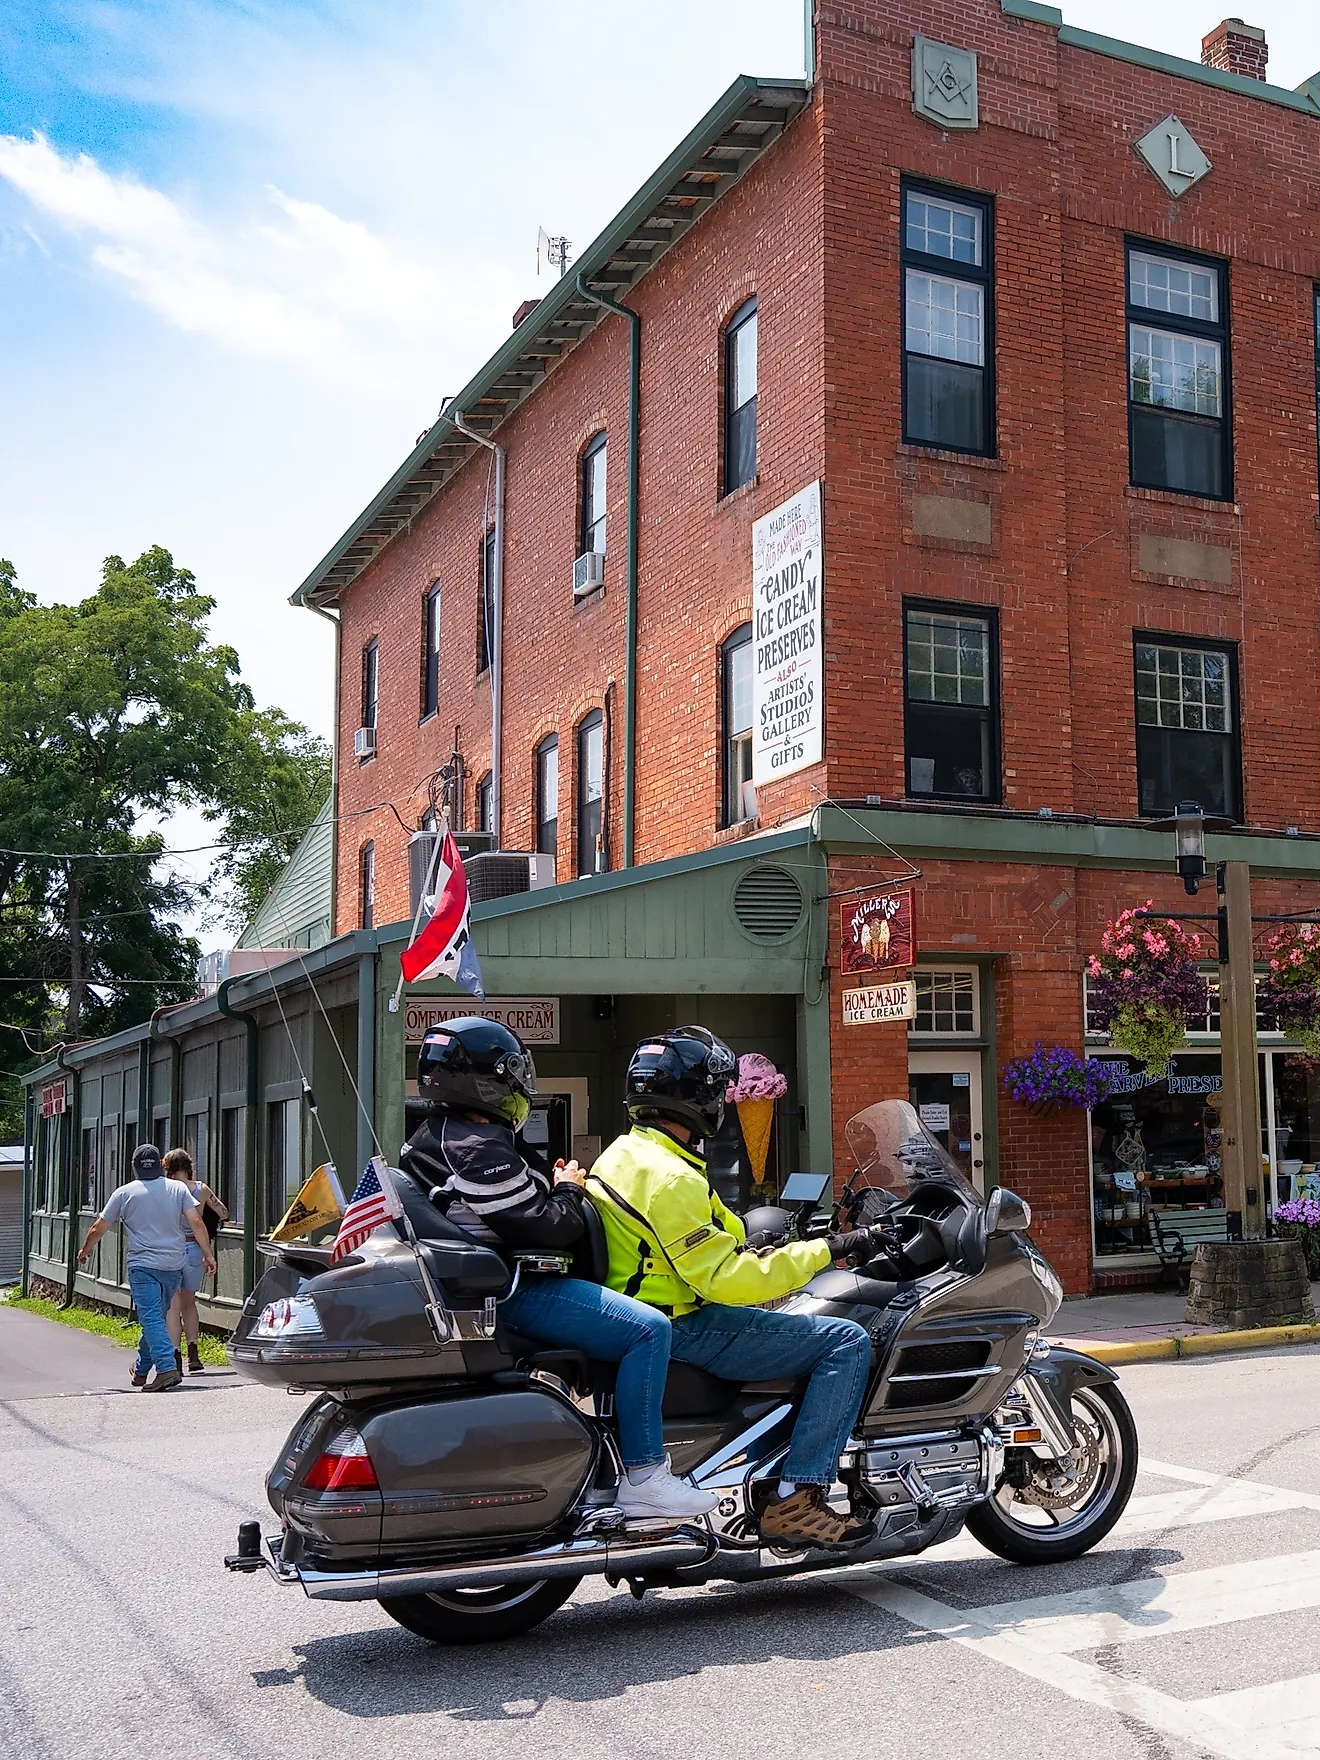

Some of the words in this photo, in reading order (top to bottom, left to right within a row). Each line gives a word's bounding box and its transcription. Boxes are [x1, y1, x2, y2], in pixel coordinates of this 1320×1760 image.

[769, 513, 786, 538] MADE
[786, 503, 802, 526] HERE
[777, 518, 807, 562] FASHIONED
[790, 538, 802, 556] WAY
[760, 549, 812, 604] CANDY
[756, 608, 774, 643] ICE
[777, 575, 818, 631] CREAM
[757, 618, 815, 675] PRESERVES
[767, 672, 807, 705] ARTISTS'
[776, 660, 797, 683] ALSO
[760, 680, 814, 726] STUDIOS
[762, 706, 813, 742] GALLERY
[783, 734, 791, 747] &
[771, 742, 804, 769] GIFTS
[850, 895, 901, 943] MILLER'S
[844, 986, 908, 1011] HOMEMADE
[850, 1010, 865, 1021] ICE
[871, 1007, 904, 1018] CREAM
[406, 1010, 476, 1029] OMEM
[506, 1010, 554, 1029] CREAM
